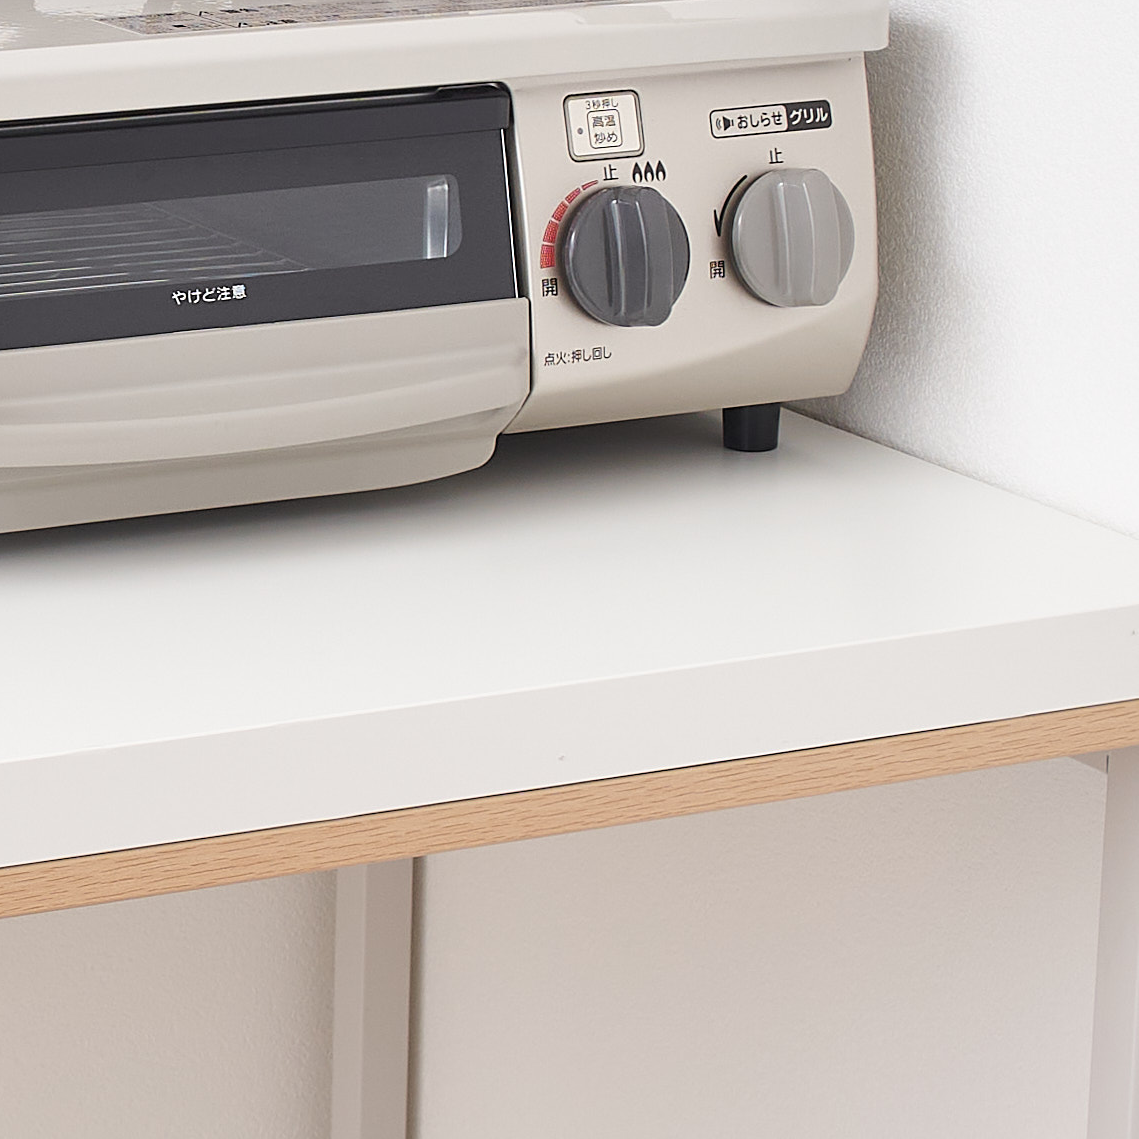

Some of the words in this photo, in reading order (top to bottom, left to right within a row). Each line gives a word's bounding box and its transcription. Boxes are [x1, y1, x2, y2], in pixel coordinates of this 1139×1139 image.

[585, 97, 619, 110] 3秒押し
[592, 114, 617, 129] 高温
[737, 111, 783, 130] おしらせ
[790, 107, 829, 126] グリル
[594, 130, 618, 145] 炒め
[769, 147, 784, 165] 止
[603, 164, 619, 182] 止
[710, 261, 726, 278] 開
[171, 284, 247, 306] やけど注意
[542, 278, 558, 297] 開
